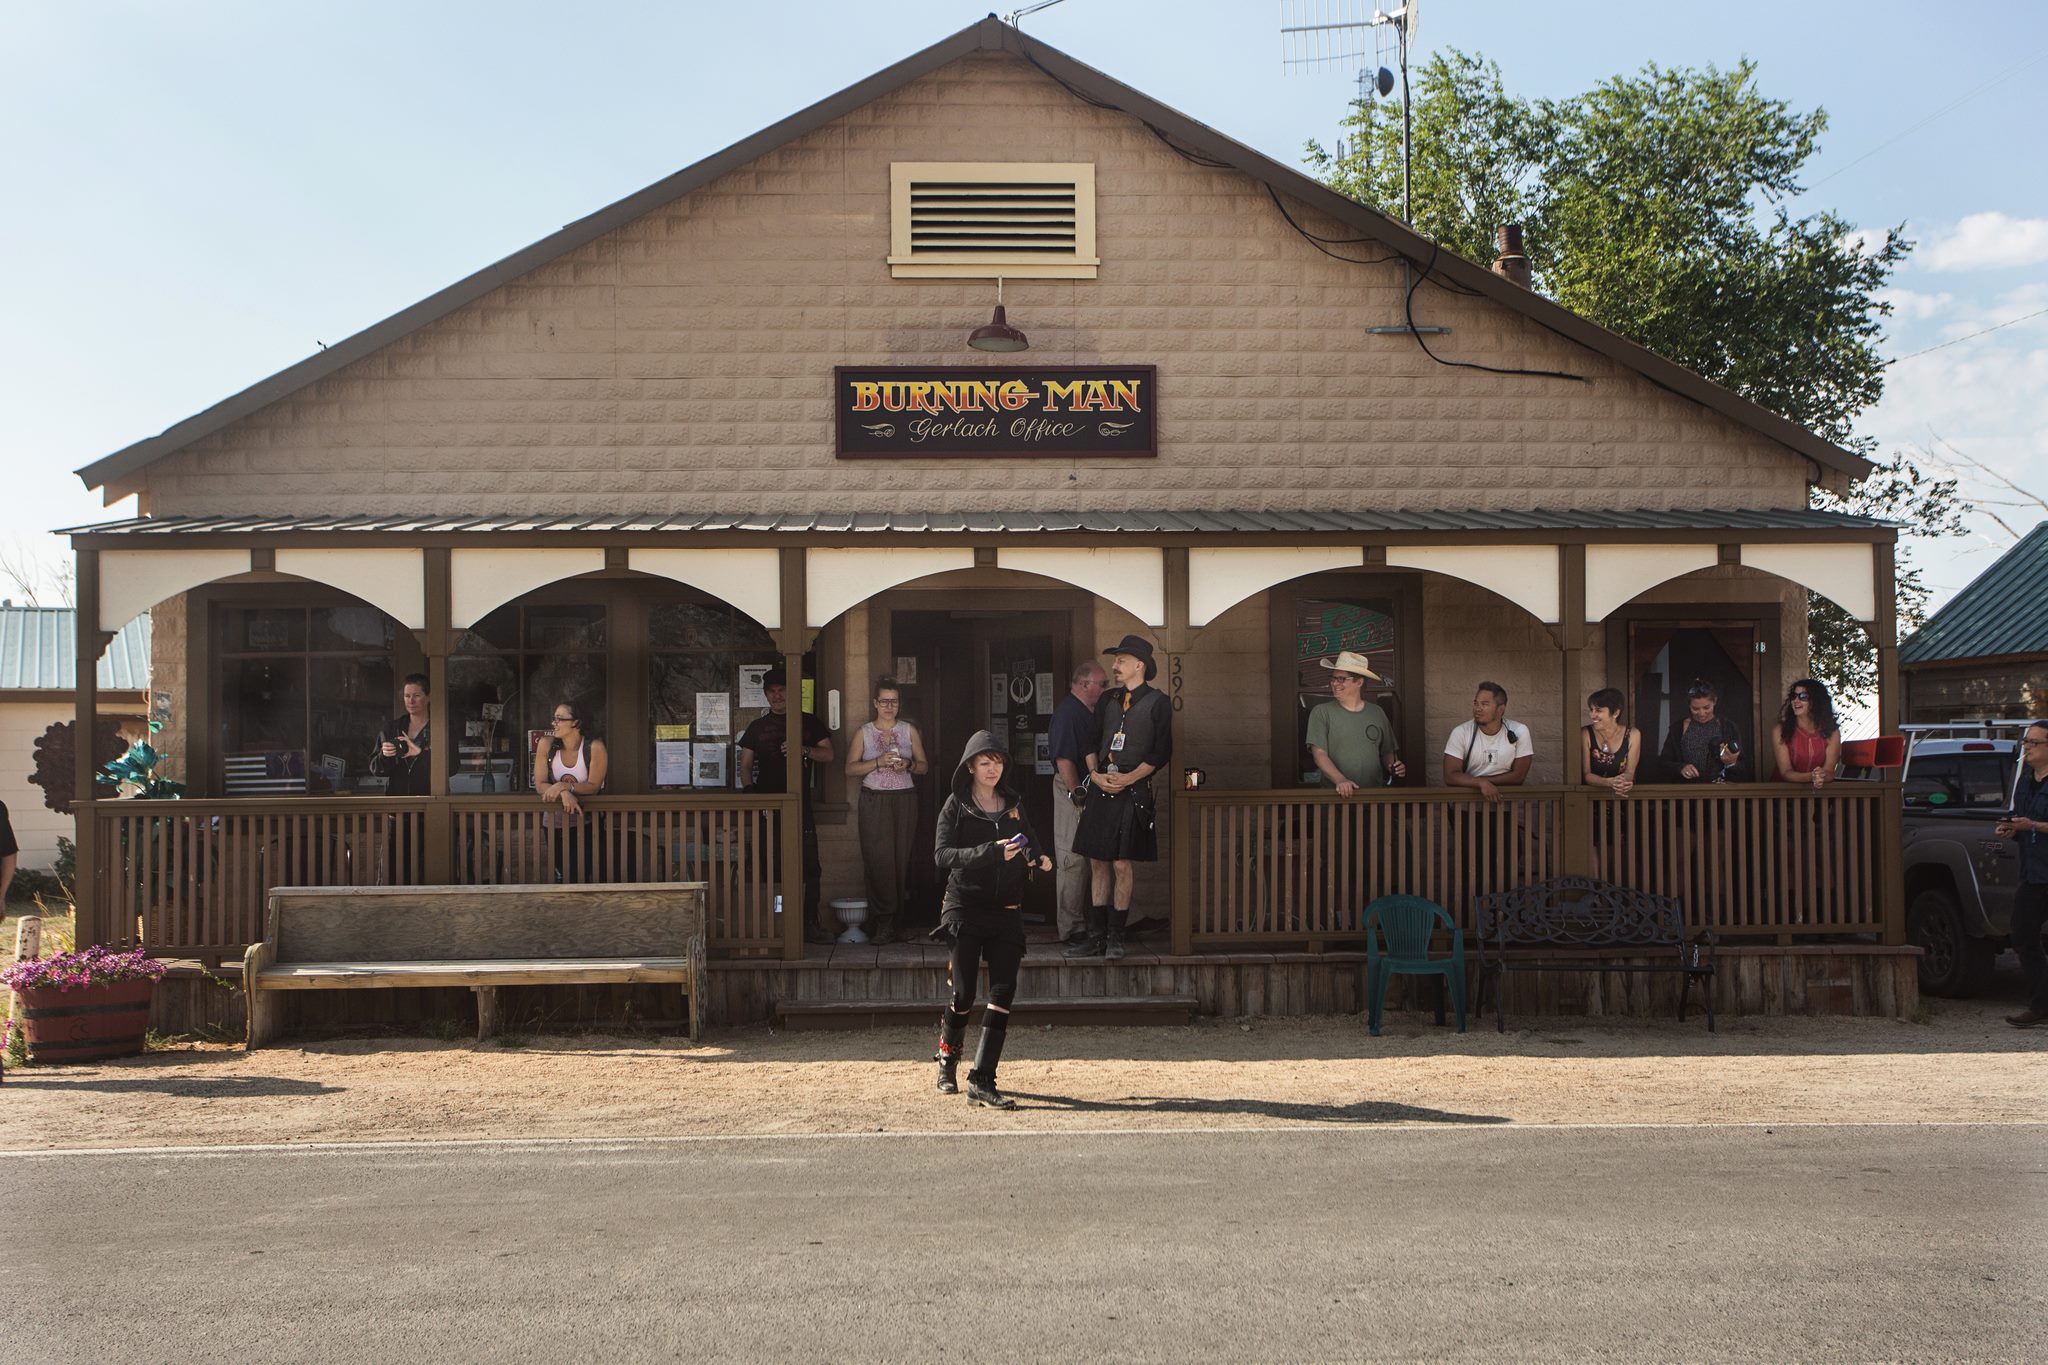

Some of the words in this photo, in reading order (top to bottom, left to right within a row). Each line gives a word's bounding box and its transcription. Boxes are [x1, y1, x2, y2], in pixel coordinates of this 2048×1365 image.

[850, 379, 1040, 416] BURNING
[1042, 379, 1141, 413] MAN
[908, 417, 1000, 443] Gerlach
[1009, 417, 1086, 442] Office
[1172, 656, 1183, 712] 390
